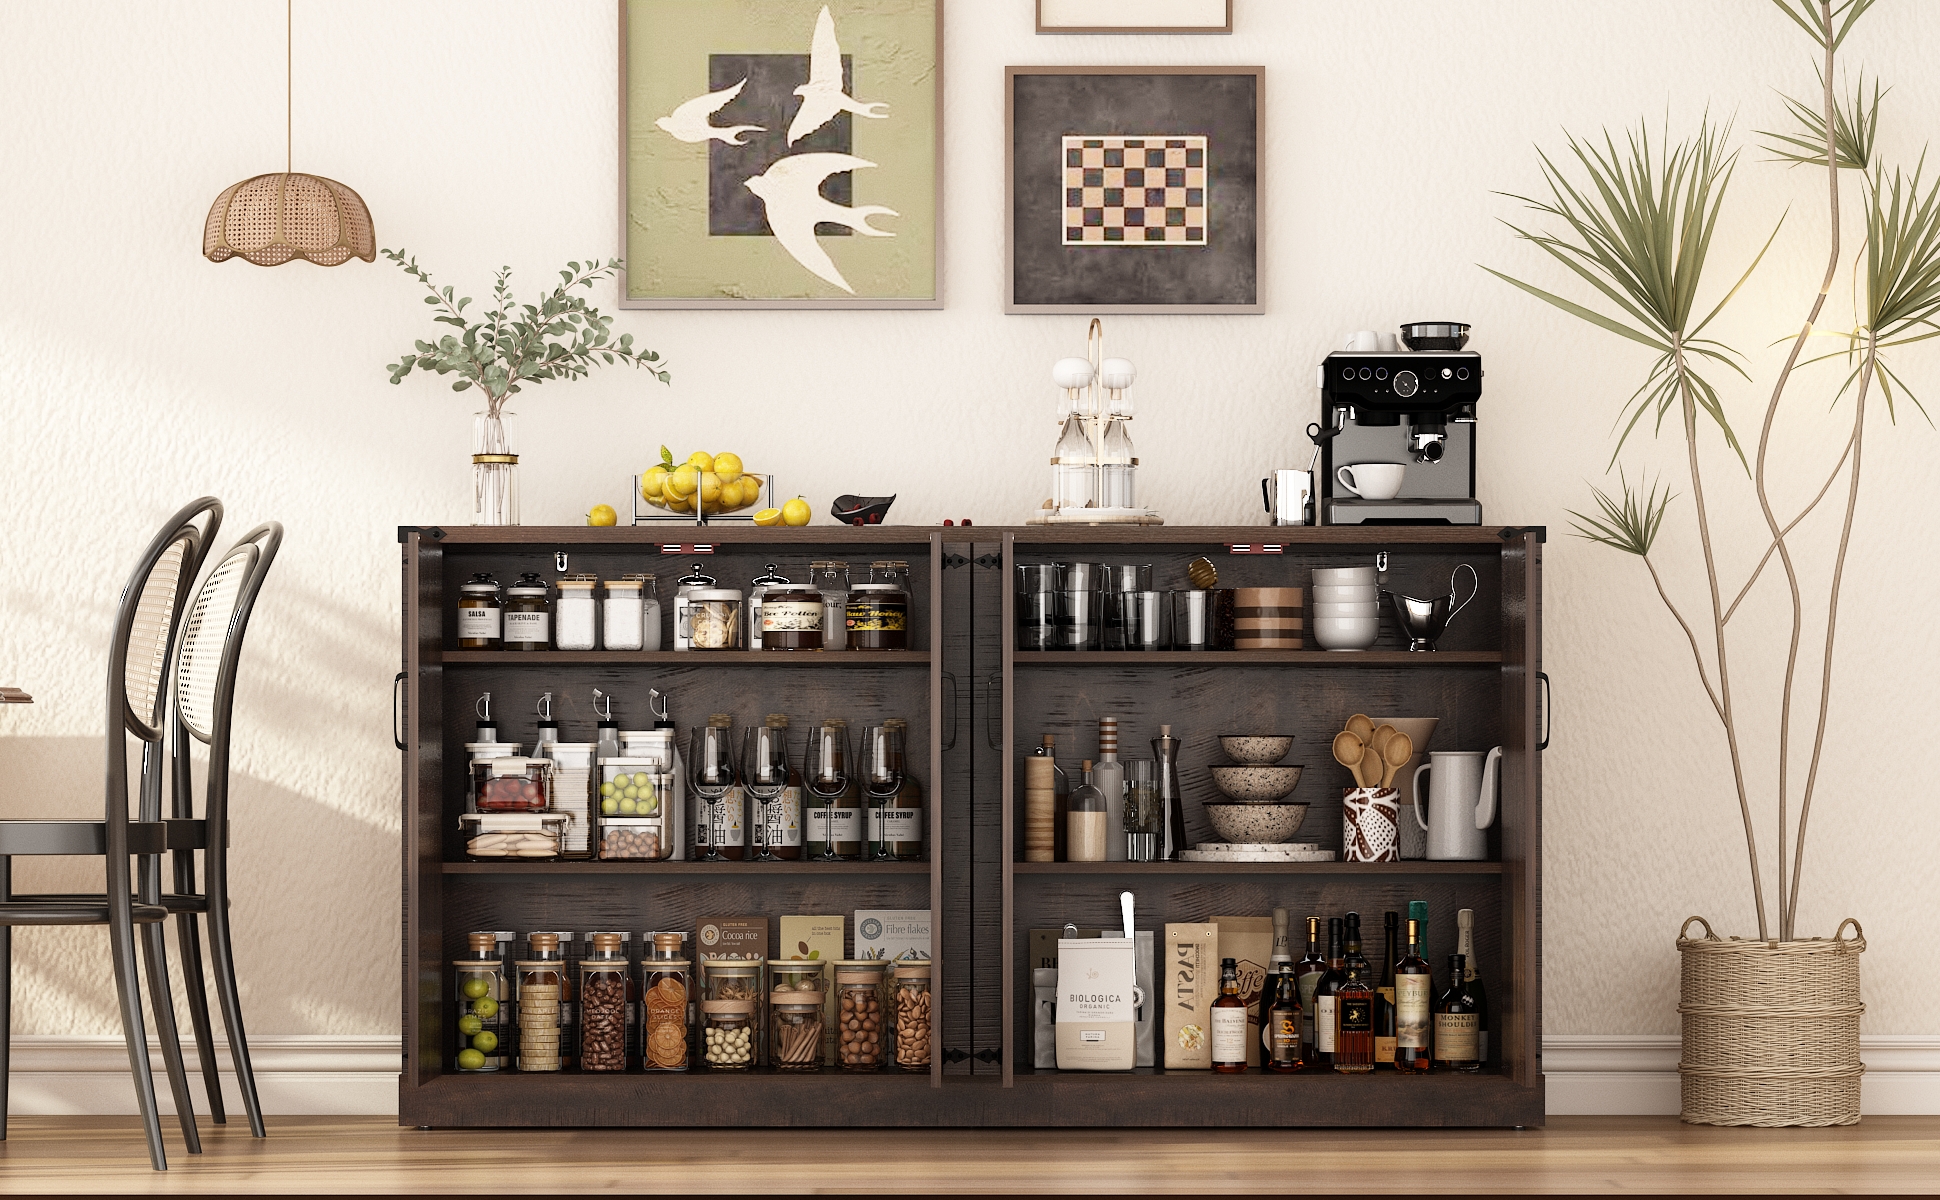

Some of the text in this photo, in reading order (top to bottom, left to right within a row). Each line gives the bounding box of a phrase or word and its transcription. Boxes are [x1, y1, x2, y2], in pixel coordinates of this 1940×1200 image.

[813, 811, 853, 819] COFFE SYRUP
[895, 811, 914, 819] SYRUP
[886, 923, 930, 934] Fibre flakes
[722, 930, 758, 940] Cocoa rice
[1069, 994, 1121, 1003] BIOLOGICA
